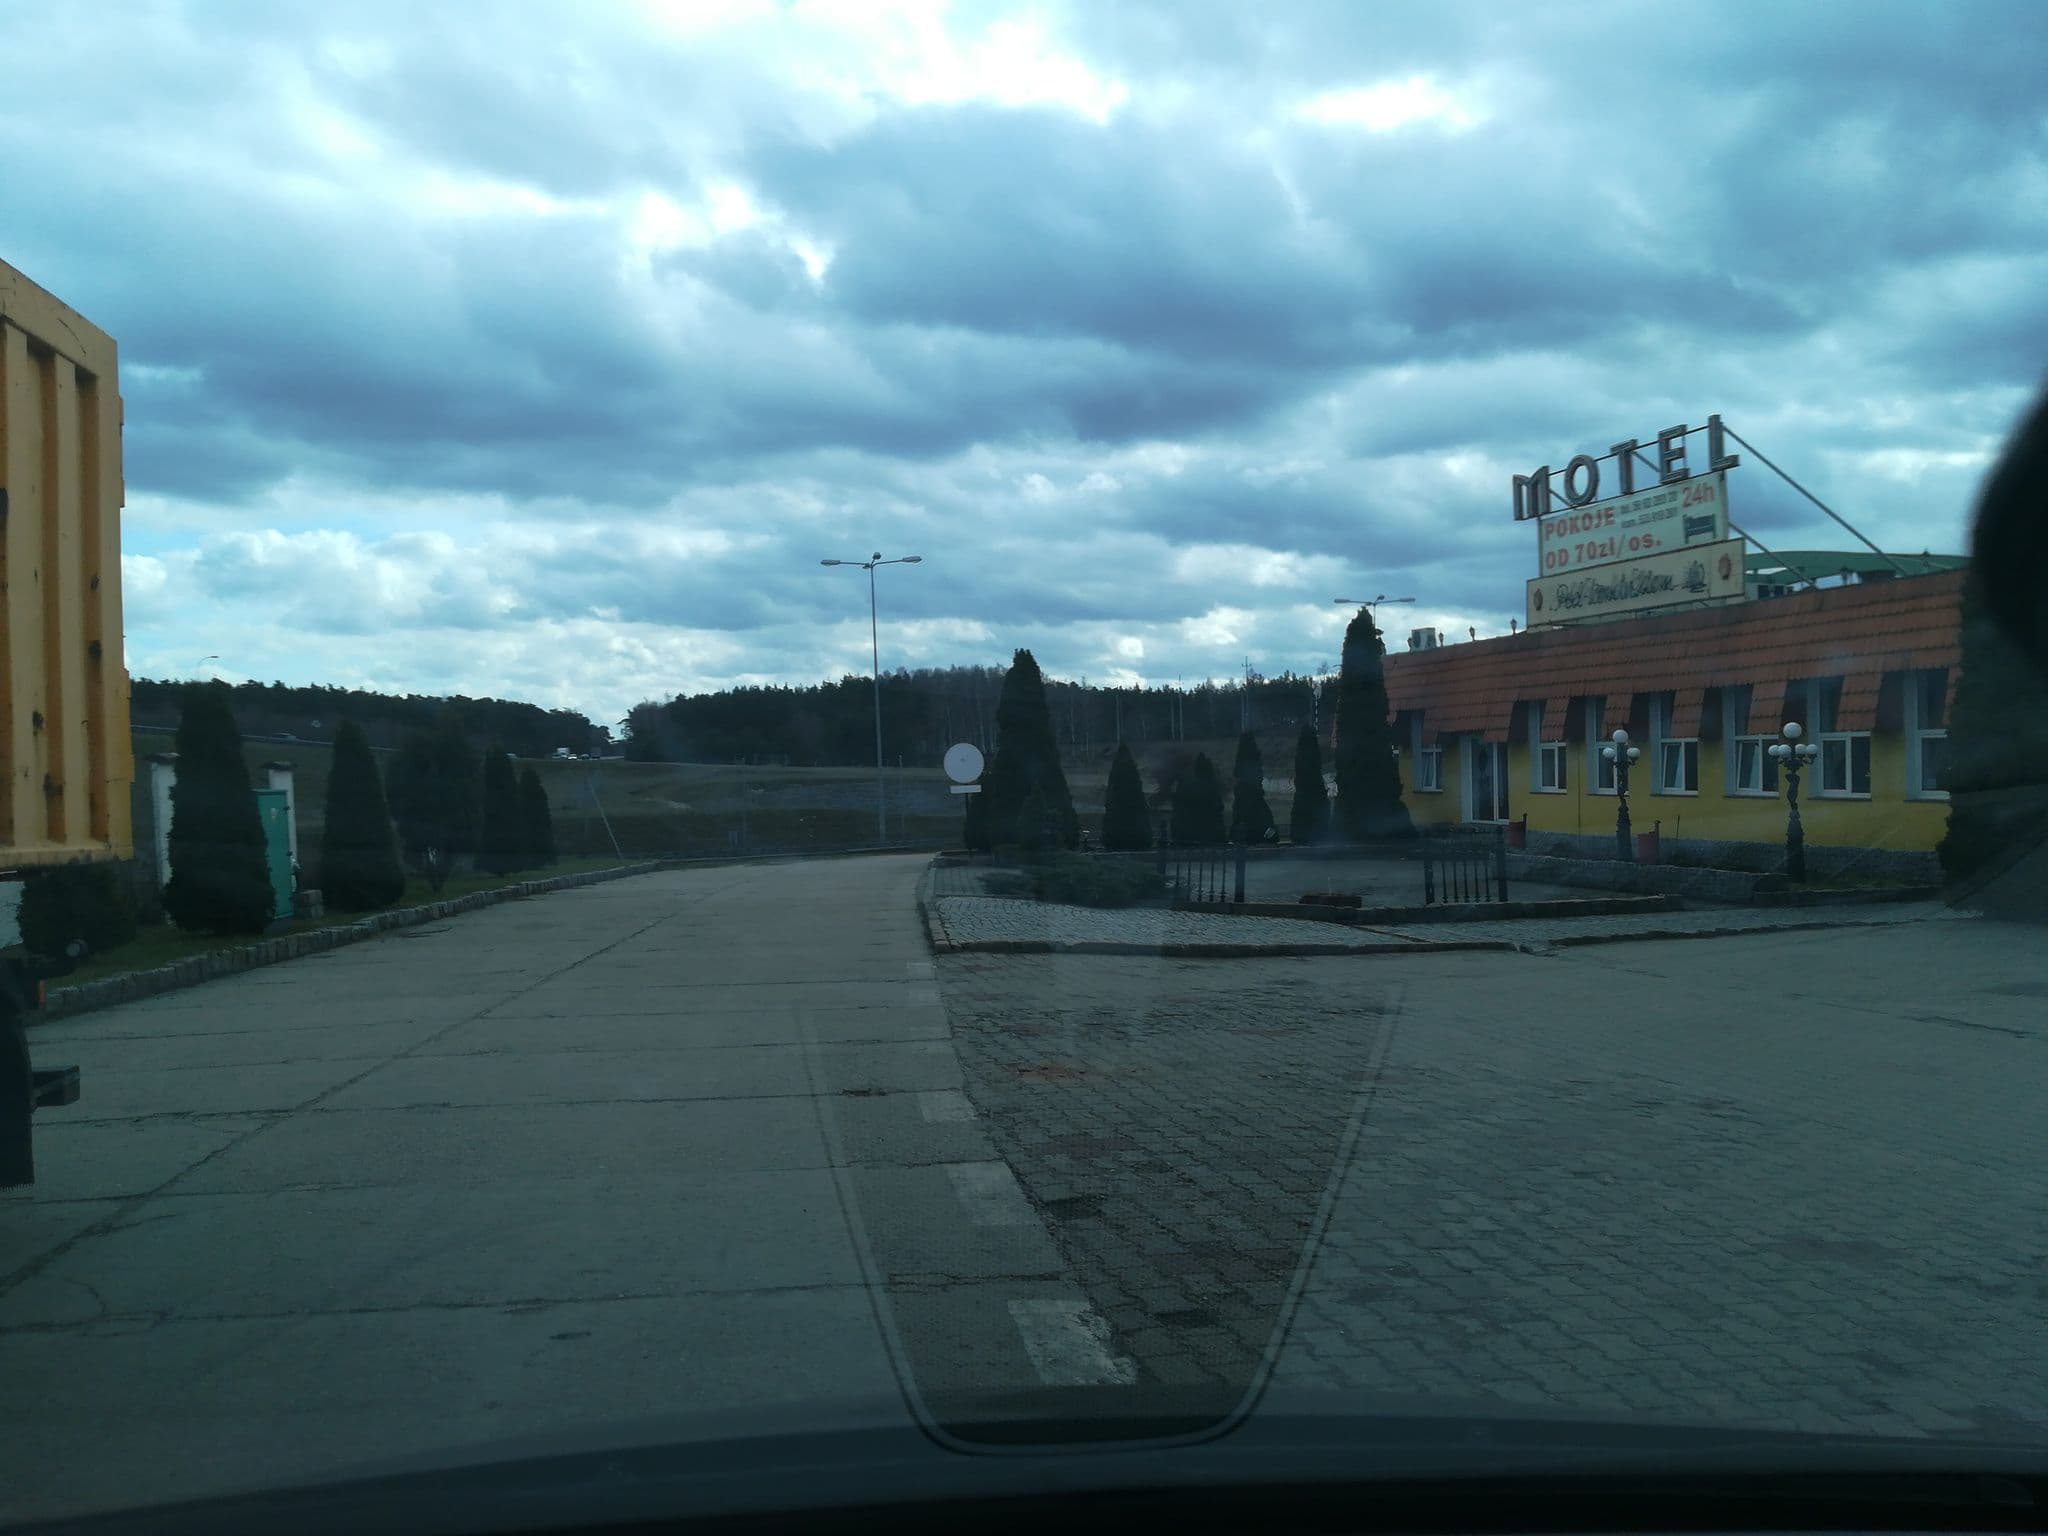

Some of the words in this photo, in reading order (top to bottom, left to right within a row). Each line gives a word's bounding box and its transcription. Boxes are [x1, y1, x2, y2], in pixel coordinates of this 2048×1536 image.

[1513, 415, 1740, 521] MOTEL
[1682, 481, 1715, 508] 24h
[1544, 506, 1615, 541] POKOJE
[1545, 548, 1569, 569] OD
